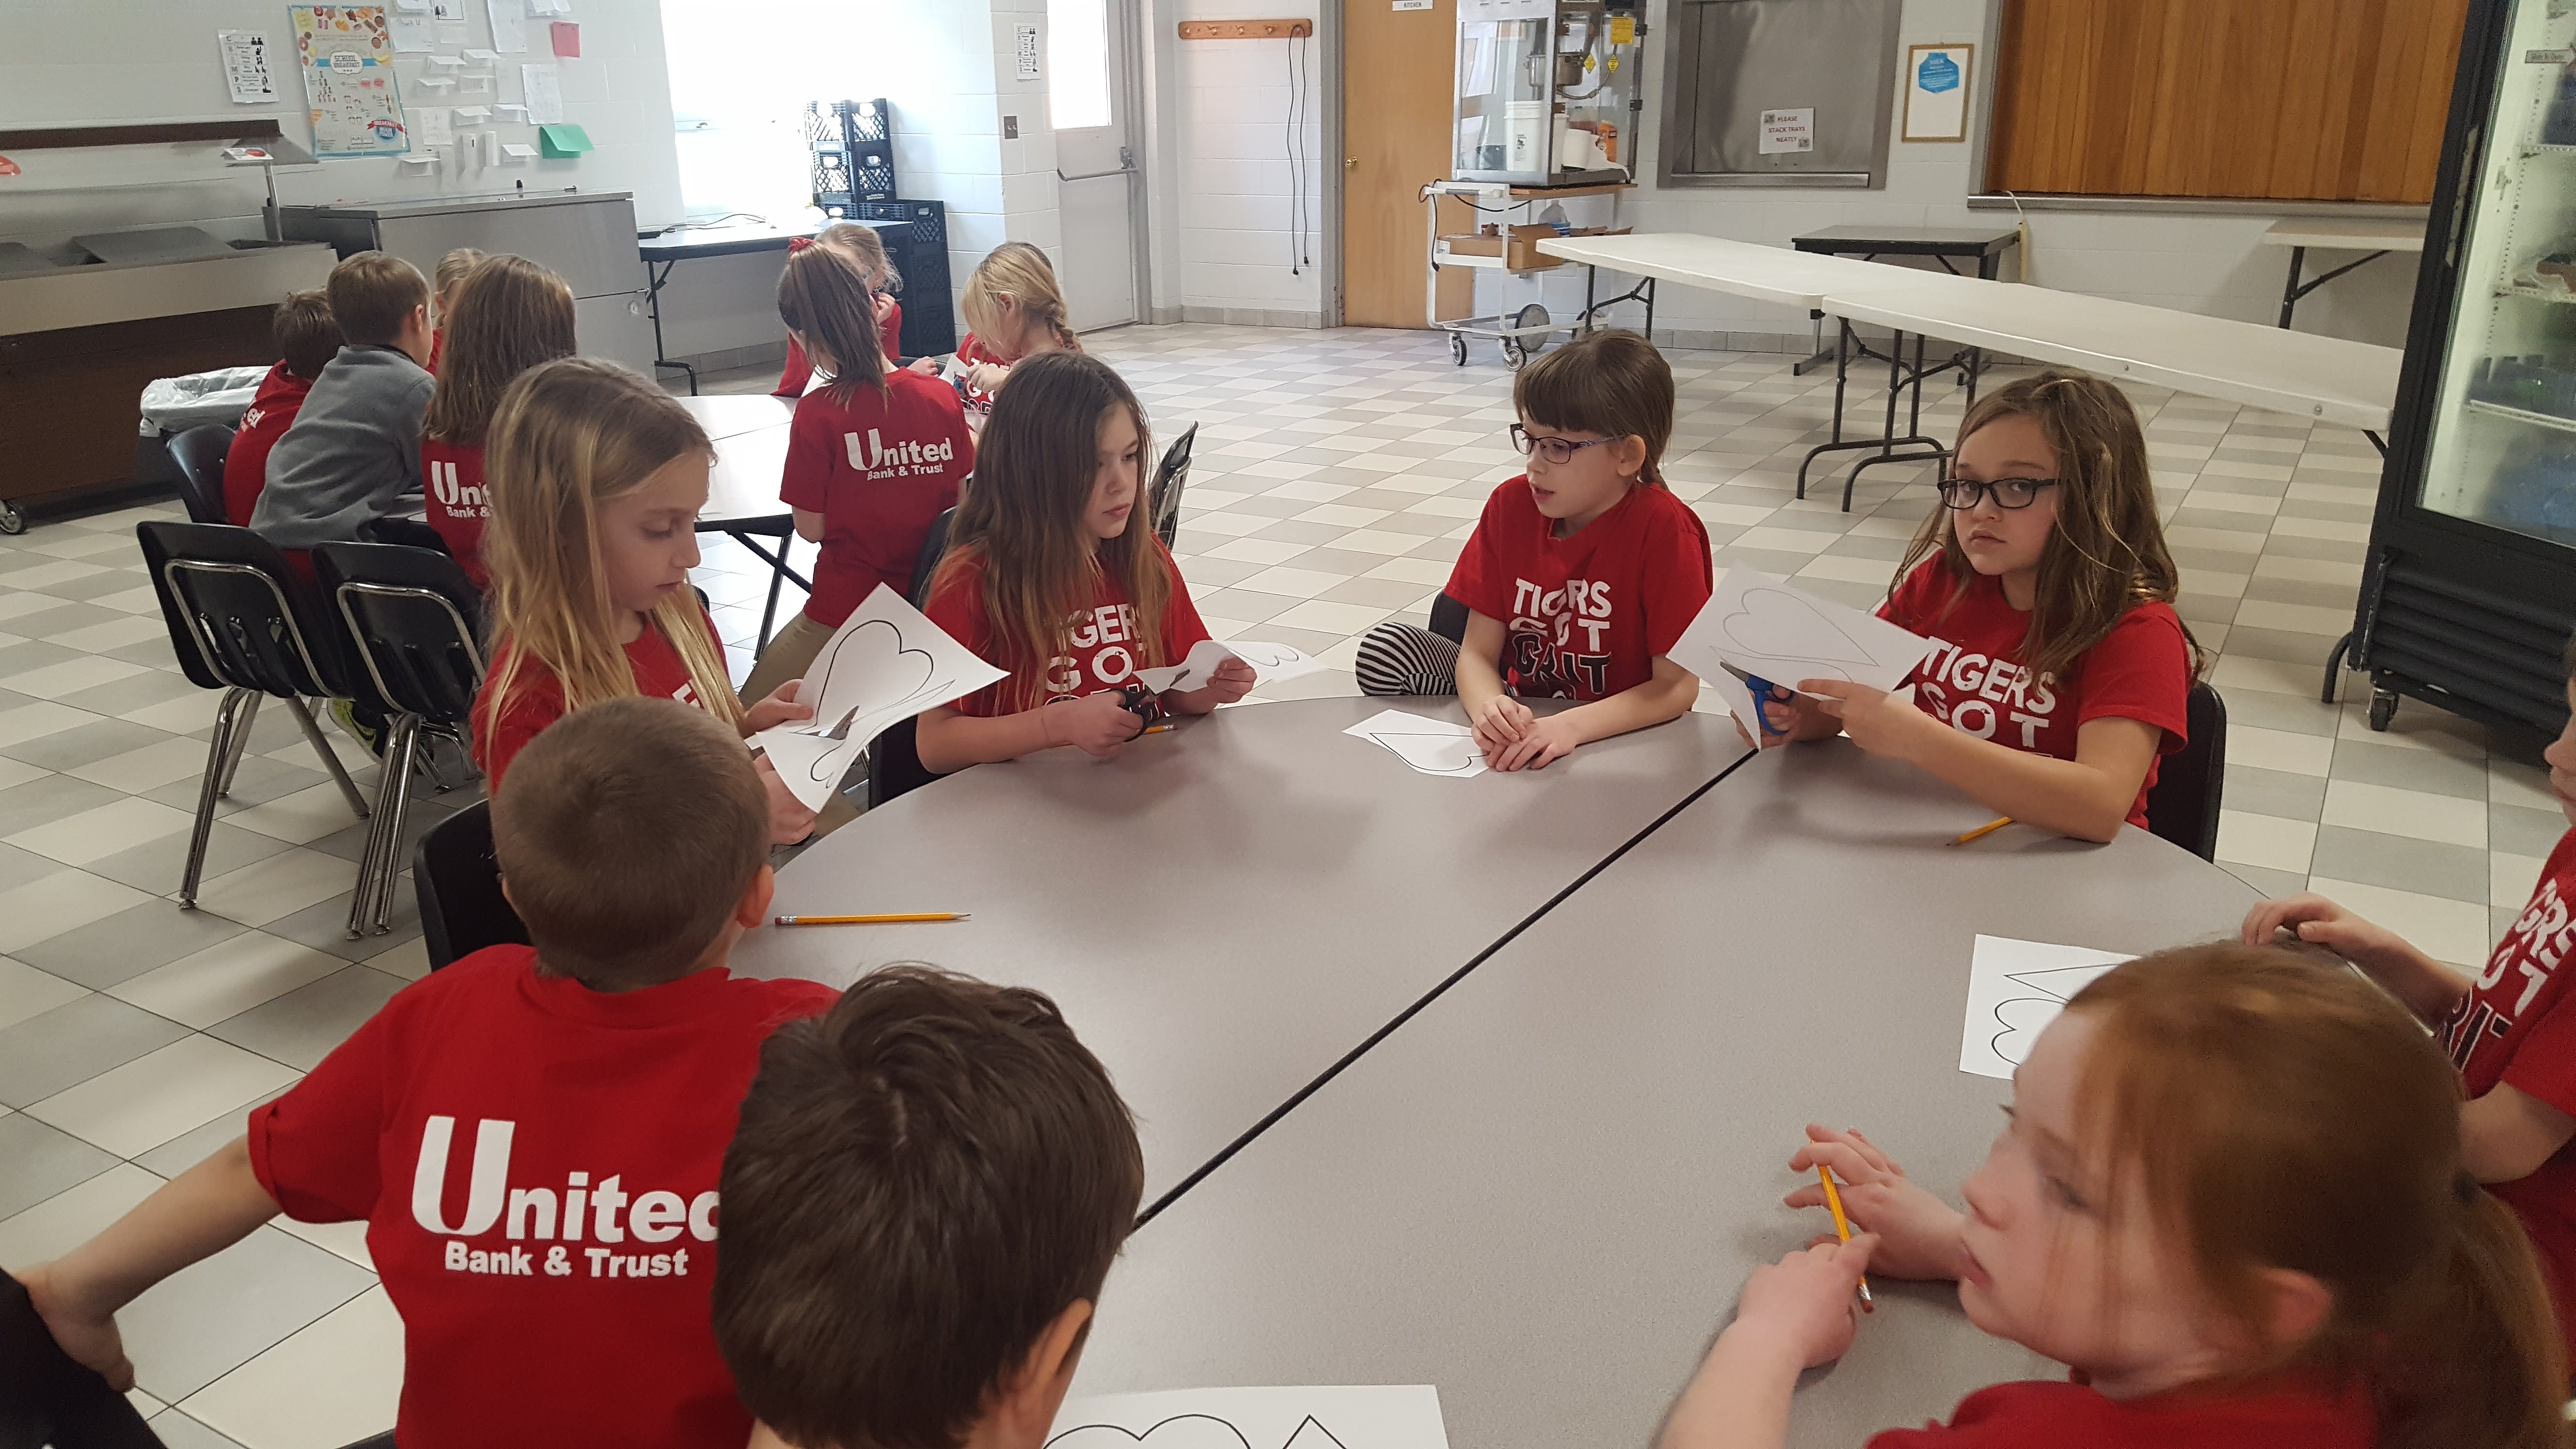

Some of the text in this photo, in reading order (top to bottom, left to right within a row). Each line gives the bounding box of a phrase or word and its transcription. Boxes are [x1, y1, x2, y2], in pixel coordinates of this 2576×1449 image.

[844, 428, 954, 470] United
[867, 463, 944, 481] Bank & Trust
[446, 506, 492, 518] Bank &
[1513, 577, 1612, 619] TIGRS
[1045, 643, 1145, 693] GO
[1921, 635, 2057, 715] TIGERS
[1921, 681, 2050, 749] GOT
[445, 1240, 690, 1278] Bank & Trust
